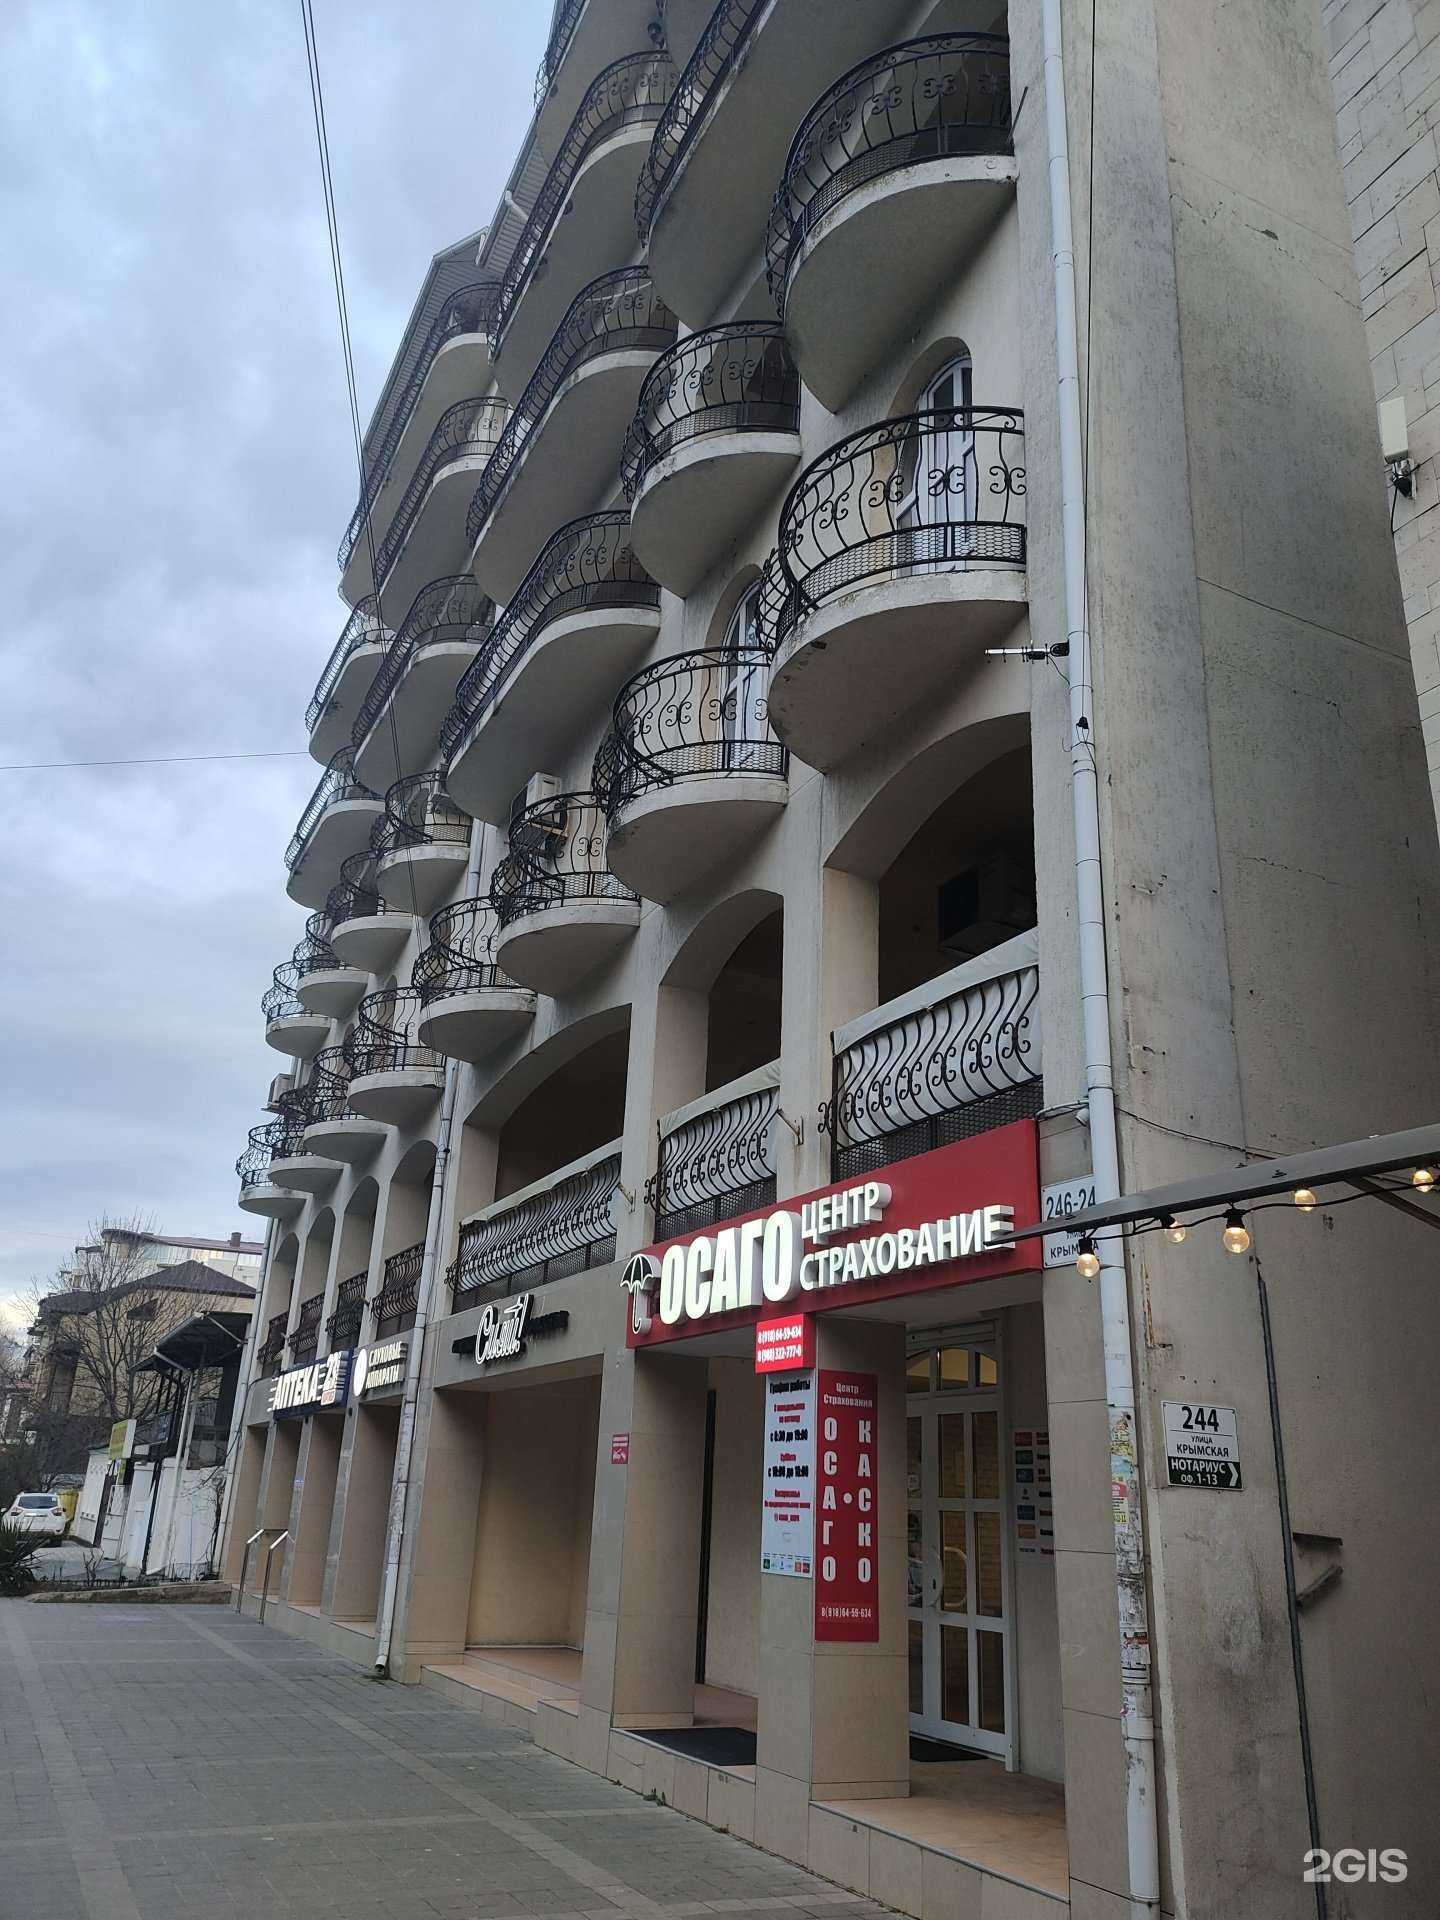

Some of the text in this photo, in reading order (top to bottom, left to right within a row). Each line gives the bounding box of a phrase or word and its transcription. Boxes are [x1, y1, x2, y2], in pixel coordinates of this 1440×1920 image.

[801, 1182, 885, 1244] ЦЕНТР
[800, 1205, 1012, 1291] СТРАХОВАНИЕ
[660, 1210, 794, 1325] ОСАГО
[272, 1362, 321, 1412] АПТЕКА
[836, 1383, 859, 1394] Центр
[823, 1394, 873, 1408] Страхования
[1181, 1406, 1220, 1432] 244
[1176, 1443, 1229, 1457] КРЫМСКАЯ
[1191, 1435, 1214, 1444] УЛИЦА
[1171, 1458, 1226, 1474] НОТАРИУС
[1197, 1473, 1218, 1485] 1-13
[822, 1417, 838, 1582] ОСАГО
[857, 1419, 872, 1583] КАСКО
[821, 1606, 872, 1618] 8(918)64-59-634
